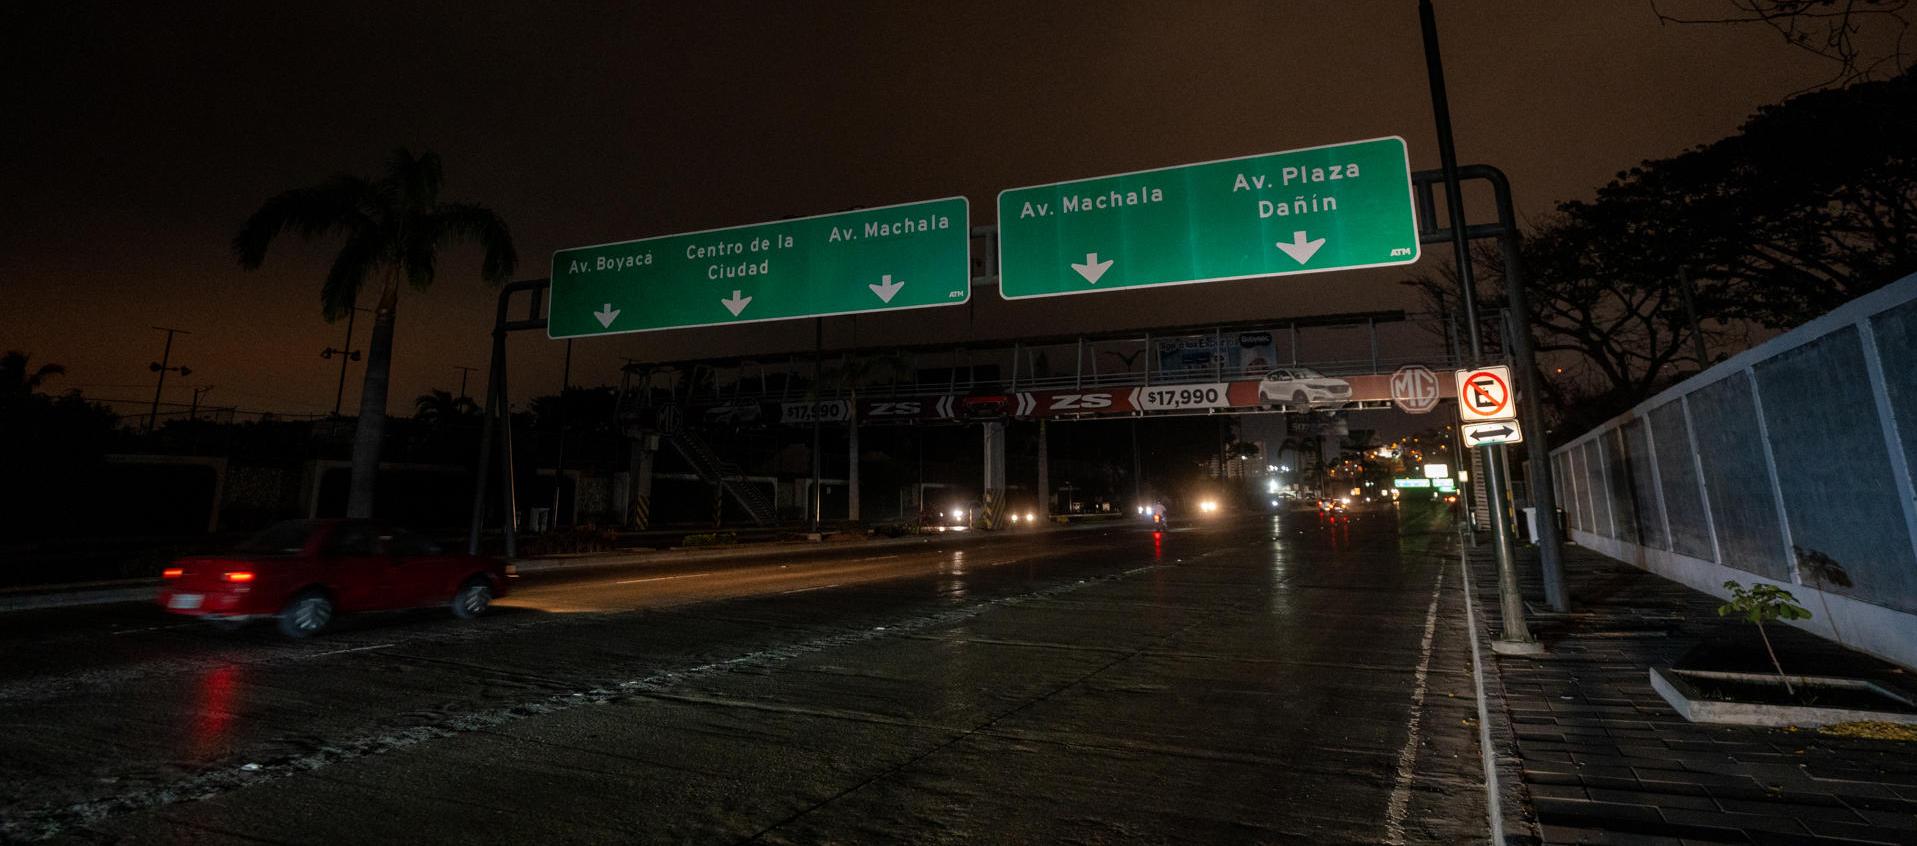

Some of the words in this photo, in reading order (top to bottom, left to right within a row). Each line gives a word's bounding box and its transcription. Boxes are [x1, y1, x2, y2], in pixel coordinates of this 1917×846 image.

[1233, 173, 1273, 193] Av.
[1282, 162, 1360, 186] Plaza
[1020, 201, 1055, 219] Av.
[1062, 186, 1164, 214] Machala
[1258, 193, 1337, 219] Dañín
[828, 226, 858, 243] Av.
[863, 214, 950, 239] Machala
[686, 240, 744, 260] Centro
[750, 237, 770, 252] de
[778, 234, 794, 249] la
[1390, 247, 1412, 257] ATM
[568, 259, 592, 274] Av.
[596, 249, 653, 273] Boyacá
[708, 259, 769, 280] Ciudad
[949, 290, 964, 298] ATM
[1147, 388, 1219, 408] $17,990
[1394, 367, 1435, 407] MG
[867, 402, 922, 416] ZS
[1049, 393, 1112, 411] ZS
